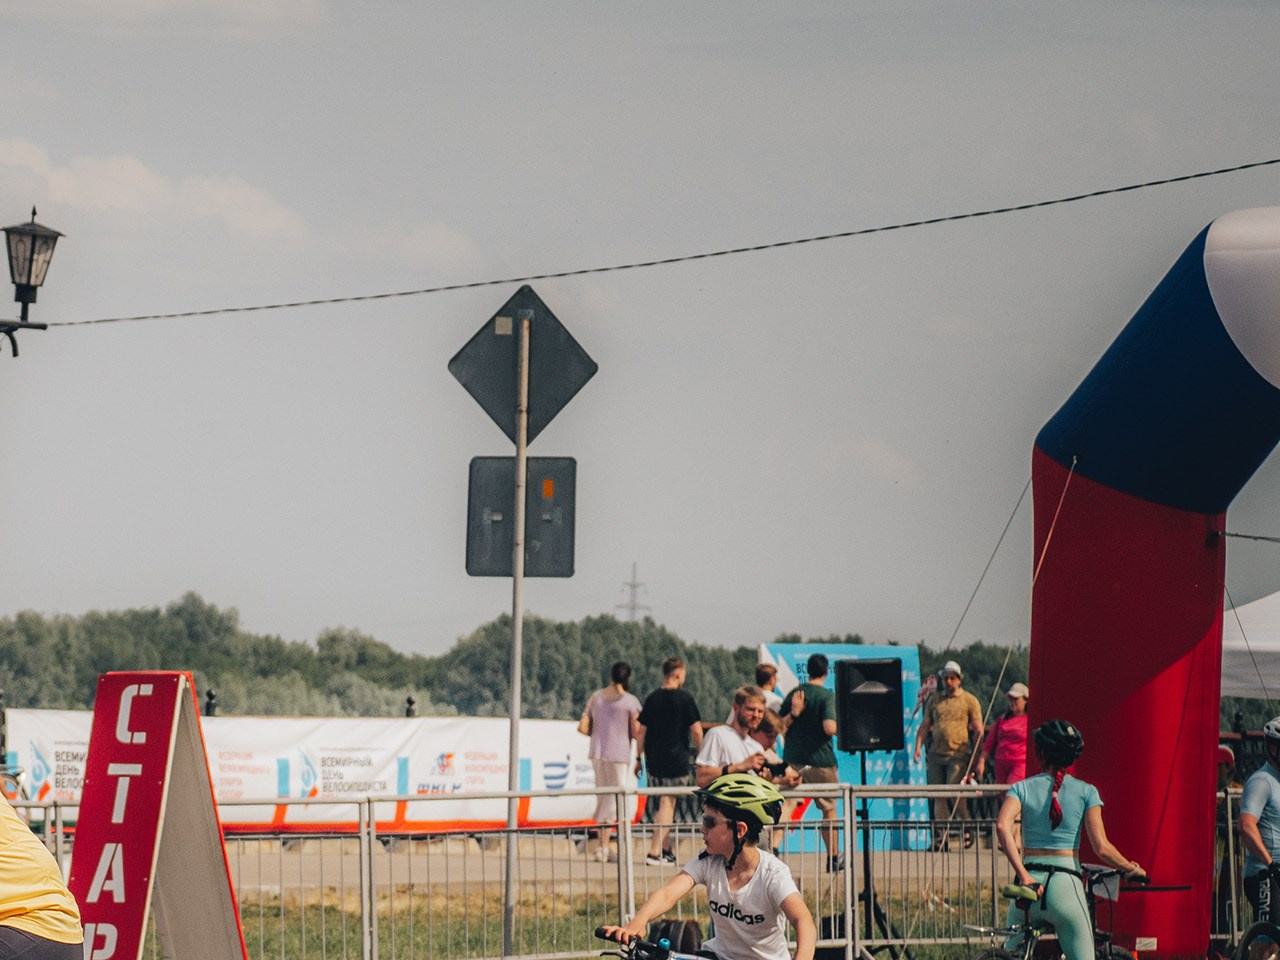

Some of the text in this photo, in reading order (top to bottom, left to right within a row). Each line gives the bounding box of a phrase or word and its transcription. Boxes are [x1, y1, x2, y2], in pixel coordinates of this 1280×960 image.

[55, 751, 86, 762] ВСЕМИ
[321, 755, 373, 767] ВСЕМИРНЫЙ
[55, 764, 80, 776] ДЕНЬ
[322, 769, 344, 781] ДЕНЬ
[322, 781, 388, 793] ВЕЛОСИПЕДИСТА
[709, 900, 765, 925] adidas
